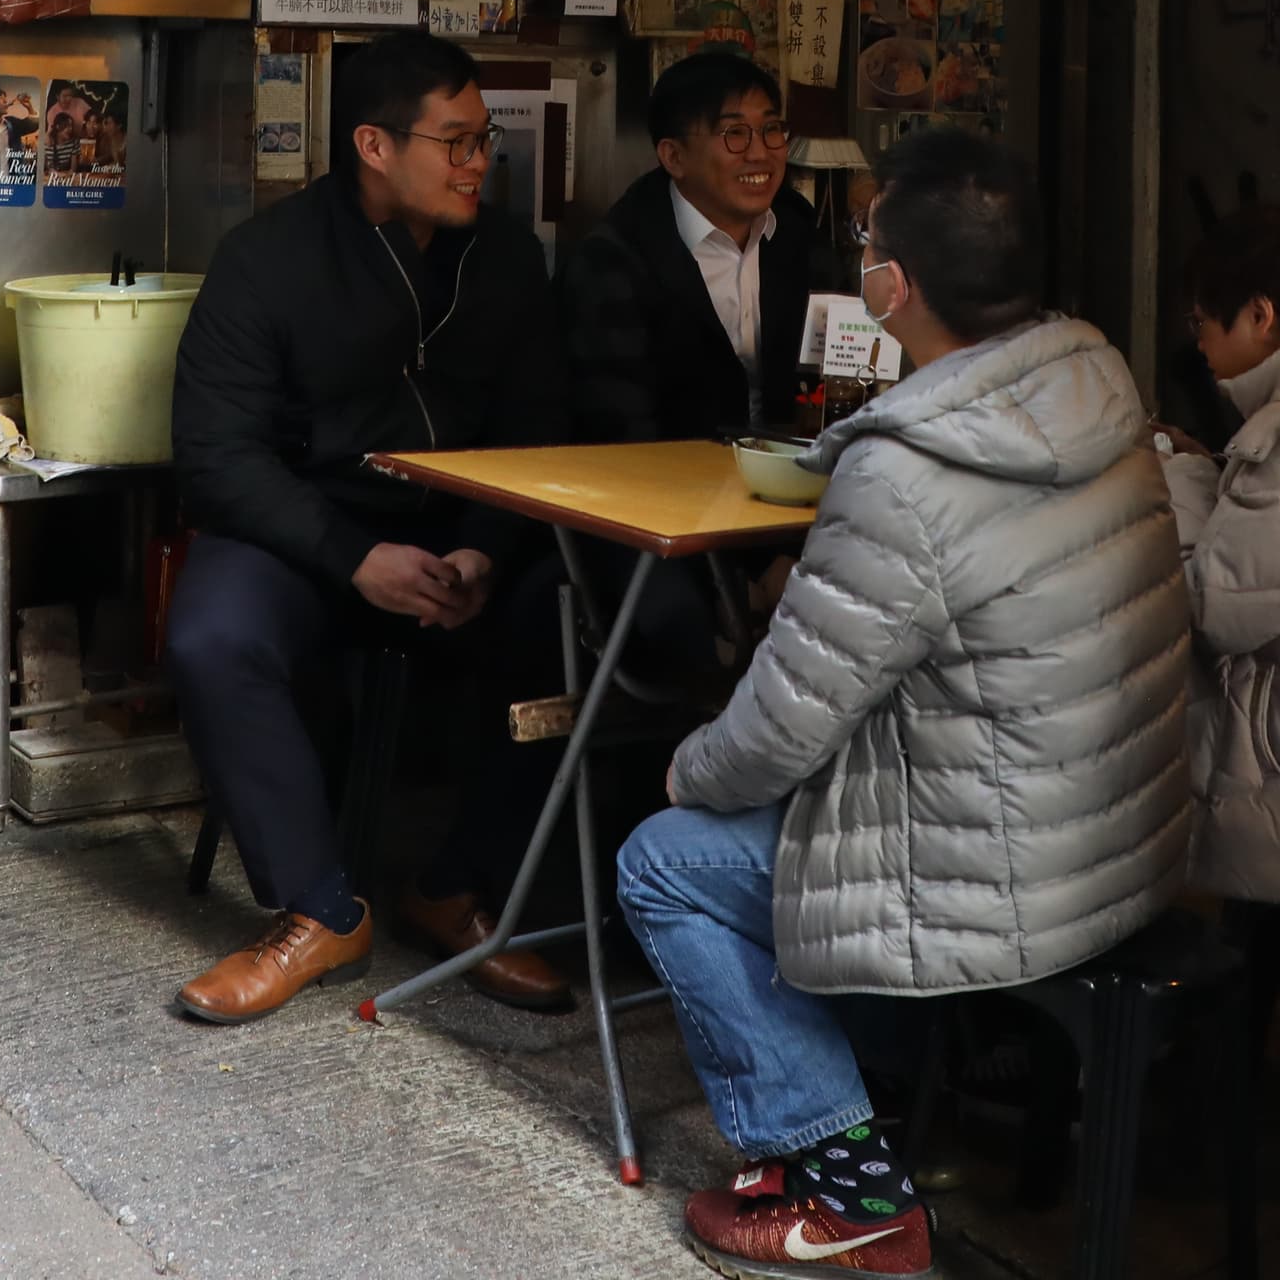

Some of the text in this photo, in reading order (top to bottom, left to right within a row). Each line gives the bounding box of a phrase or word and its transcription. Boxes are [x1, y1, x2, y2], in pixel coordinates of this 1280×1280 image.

[5, 147, 36, 159] Taste the
[8, 159, 36, 174] Real
[90, 162, 124, 173] Taste the
[47, 173, 121, 188] Real Moment
[66, 190, 104, 199] BLUE GIRL
